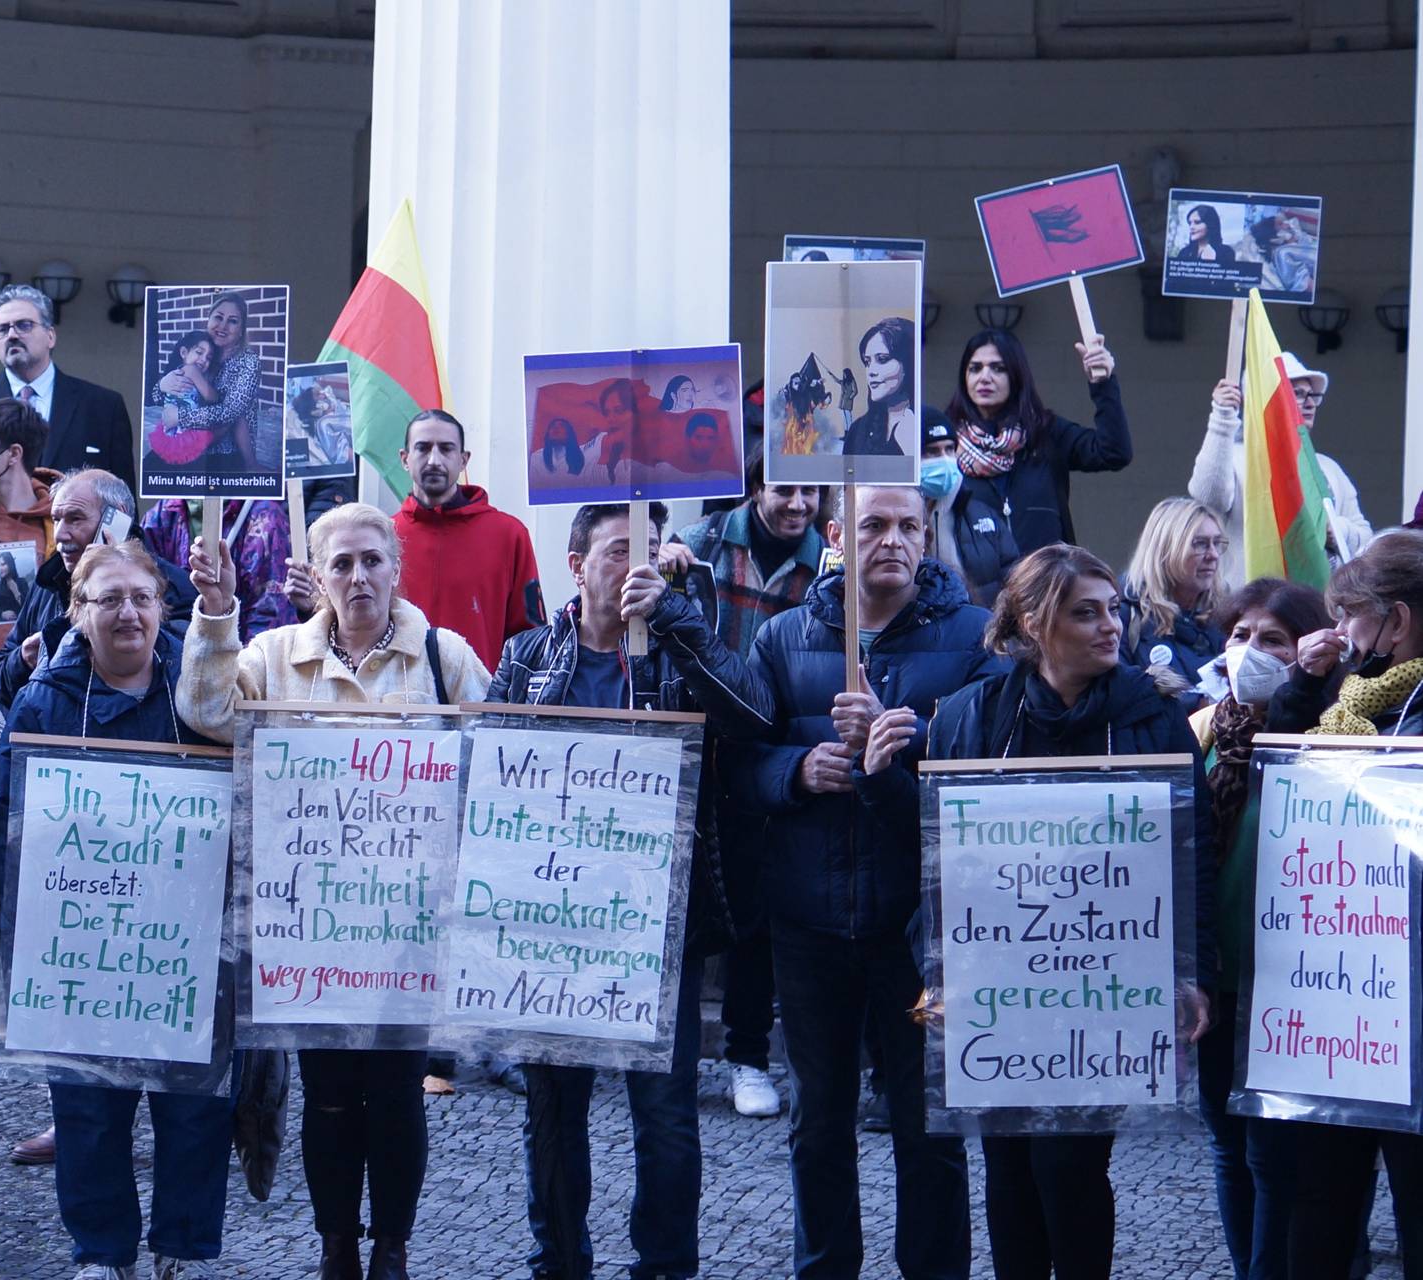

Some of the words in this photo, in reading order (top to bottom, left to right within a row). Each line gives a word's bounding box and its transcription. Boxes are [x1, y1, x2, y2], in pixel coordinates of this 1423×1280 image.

[148, 475, 174, 485] Minu
[176, 475, 207, 488] Majidi
[208, 476, 220, 486] ist
[222, 476, 276, 487] unsterblich
[350, 738, 393, 783] 40
[377, 739, 459, 798] Jahre
[497, 745, 554, 790] Wir
[555, 742, 673, 821] fordern
[116, 772, 226, 835] Jiyan,
[286, 788, 329, 819] den
[334, 787, 446, 823] Völkern
[943, 793, 1162, 848] Frauenrechte
[1269, 777, 1333, 839] Jina
[285, 826, 333, 856] das
[340, 824, 422, 858] Recht
[468, 800, 674, 871] Unterstützung
[45, 866, 143, 897] übersetzt:
[533, 851, 592, 882] der
[996, 851, 1130, 900] spiegeln
[1281, 837, 1357, 888] starb
[1365, 843, 1406, 888] nach
[256, 862, 304, 914] auf
[314, 861, 431, 908] Freiheit
[59, 900, 104, 931] Die
[107, 902, 190, 949] Frau,
[255, 907, 304, 942] und
[952, 907, 1012, 944] den
[1017, 896, 1161, 943] Zustand
[1261, 896, 1295, 931] der
[1300, 894, 1410, 940] Festnahme
[41, 936, 91, 970] das
[496, 925, 663, 979] bewegungen
[1028, 946, 1119, 974] einer
[1290, 950, 1353, 995] durch
[1362, 954, 1399, 999] die
[11, 977, 57, 1010] die
[455, 968, 496, 1010] im
[503, 970, 655, 1025] Nahosten
[967, 974, 1169, 1029] gerechten
[960, 1029, 1173, 1098] Gesellschaft
[1256, 1007, 1399, 1080] Sittenpolizei
